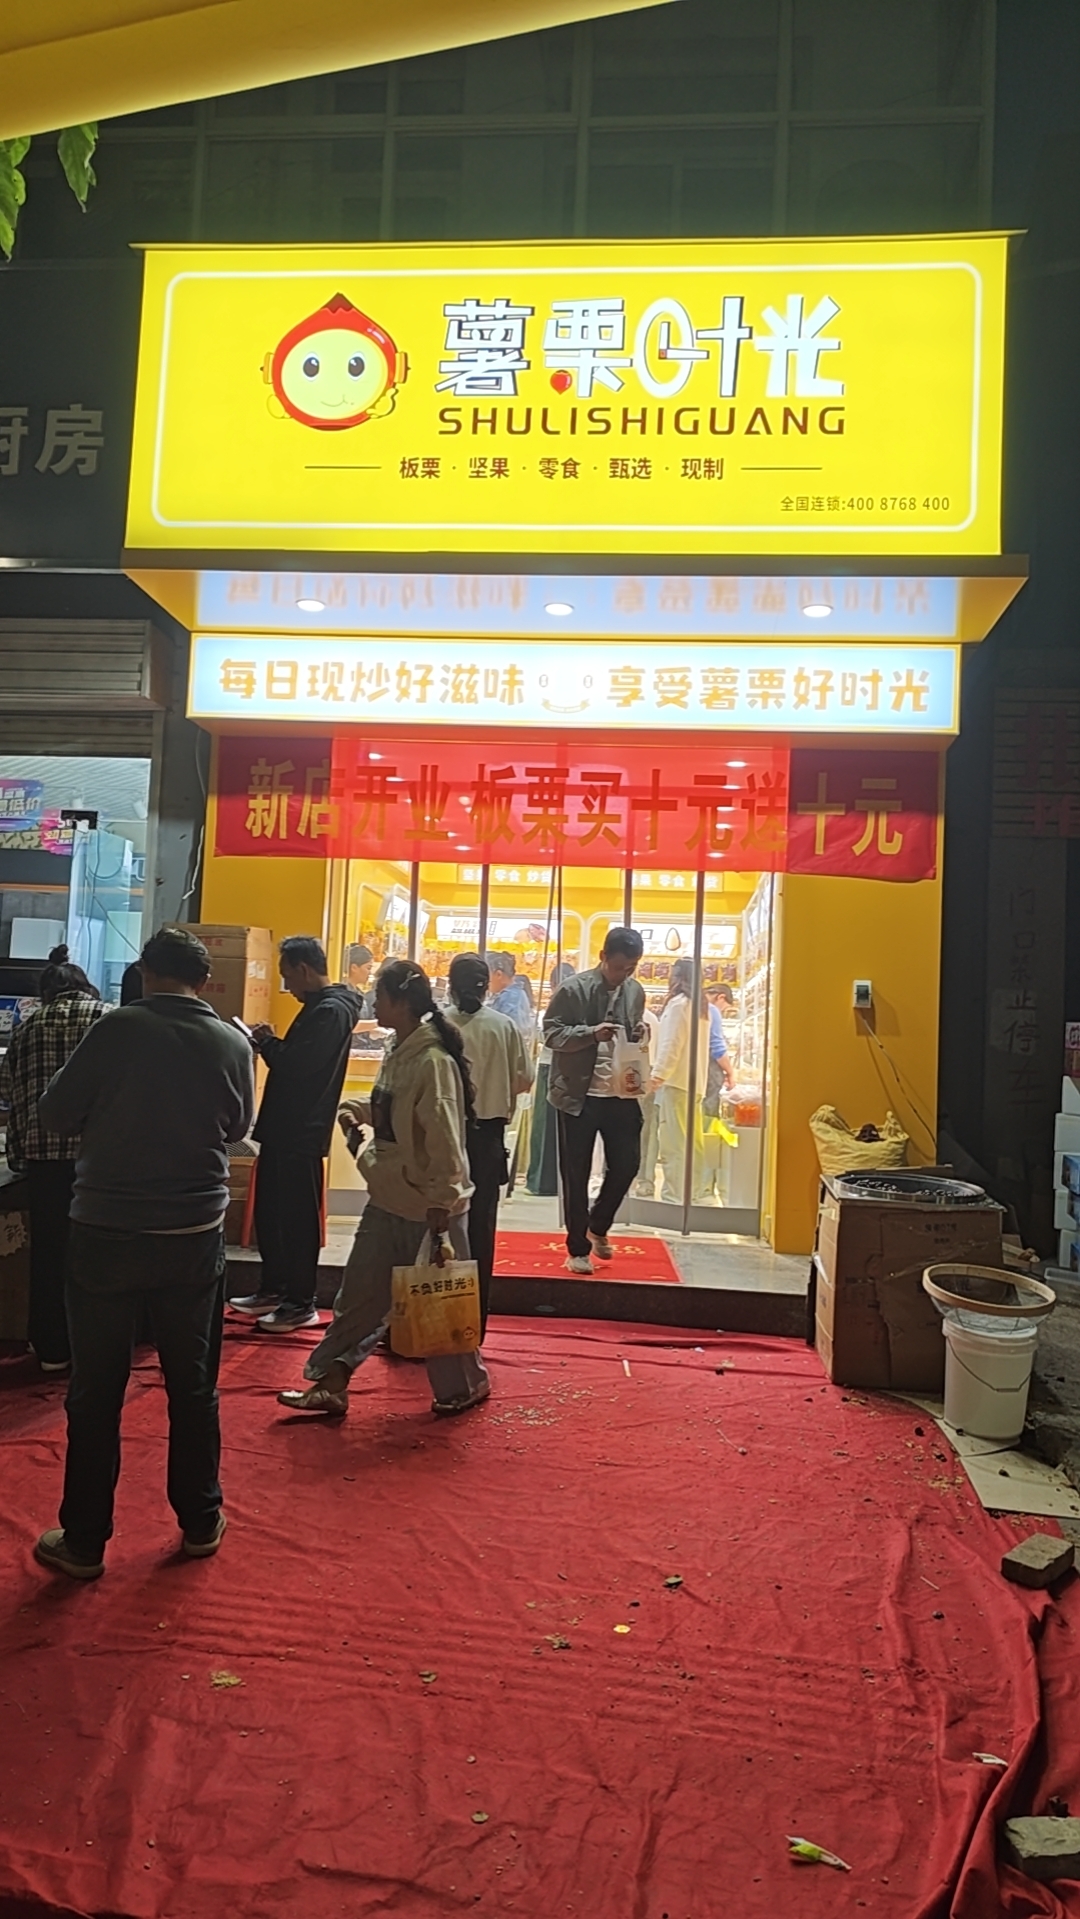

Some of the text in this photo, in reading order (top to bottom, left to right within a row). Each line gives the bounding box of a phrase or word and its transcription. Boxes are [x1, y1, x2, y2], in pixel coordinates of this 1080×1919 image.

[434, 294, 845, 399] 薯栗时光
[438, 407, 845, 435] SHULISHIGUANG
[399, 457, 724, 480] 板栗 坚果 零食 甄选 现制
[880, 497, 917, 511] 8768
[922, 497, 950, 511] 400
[218, 658, 930, 712] 每日现炒好滋味 享受薯栗好时光
